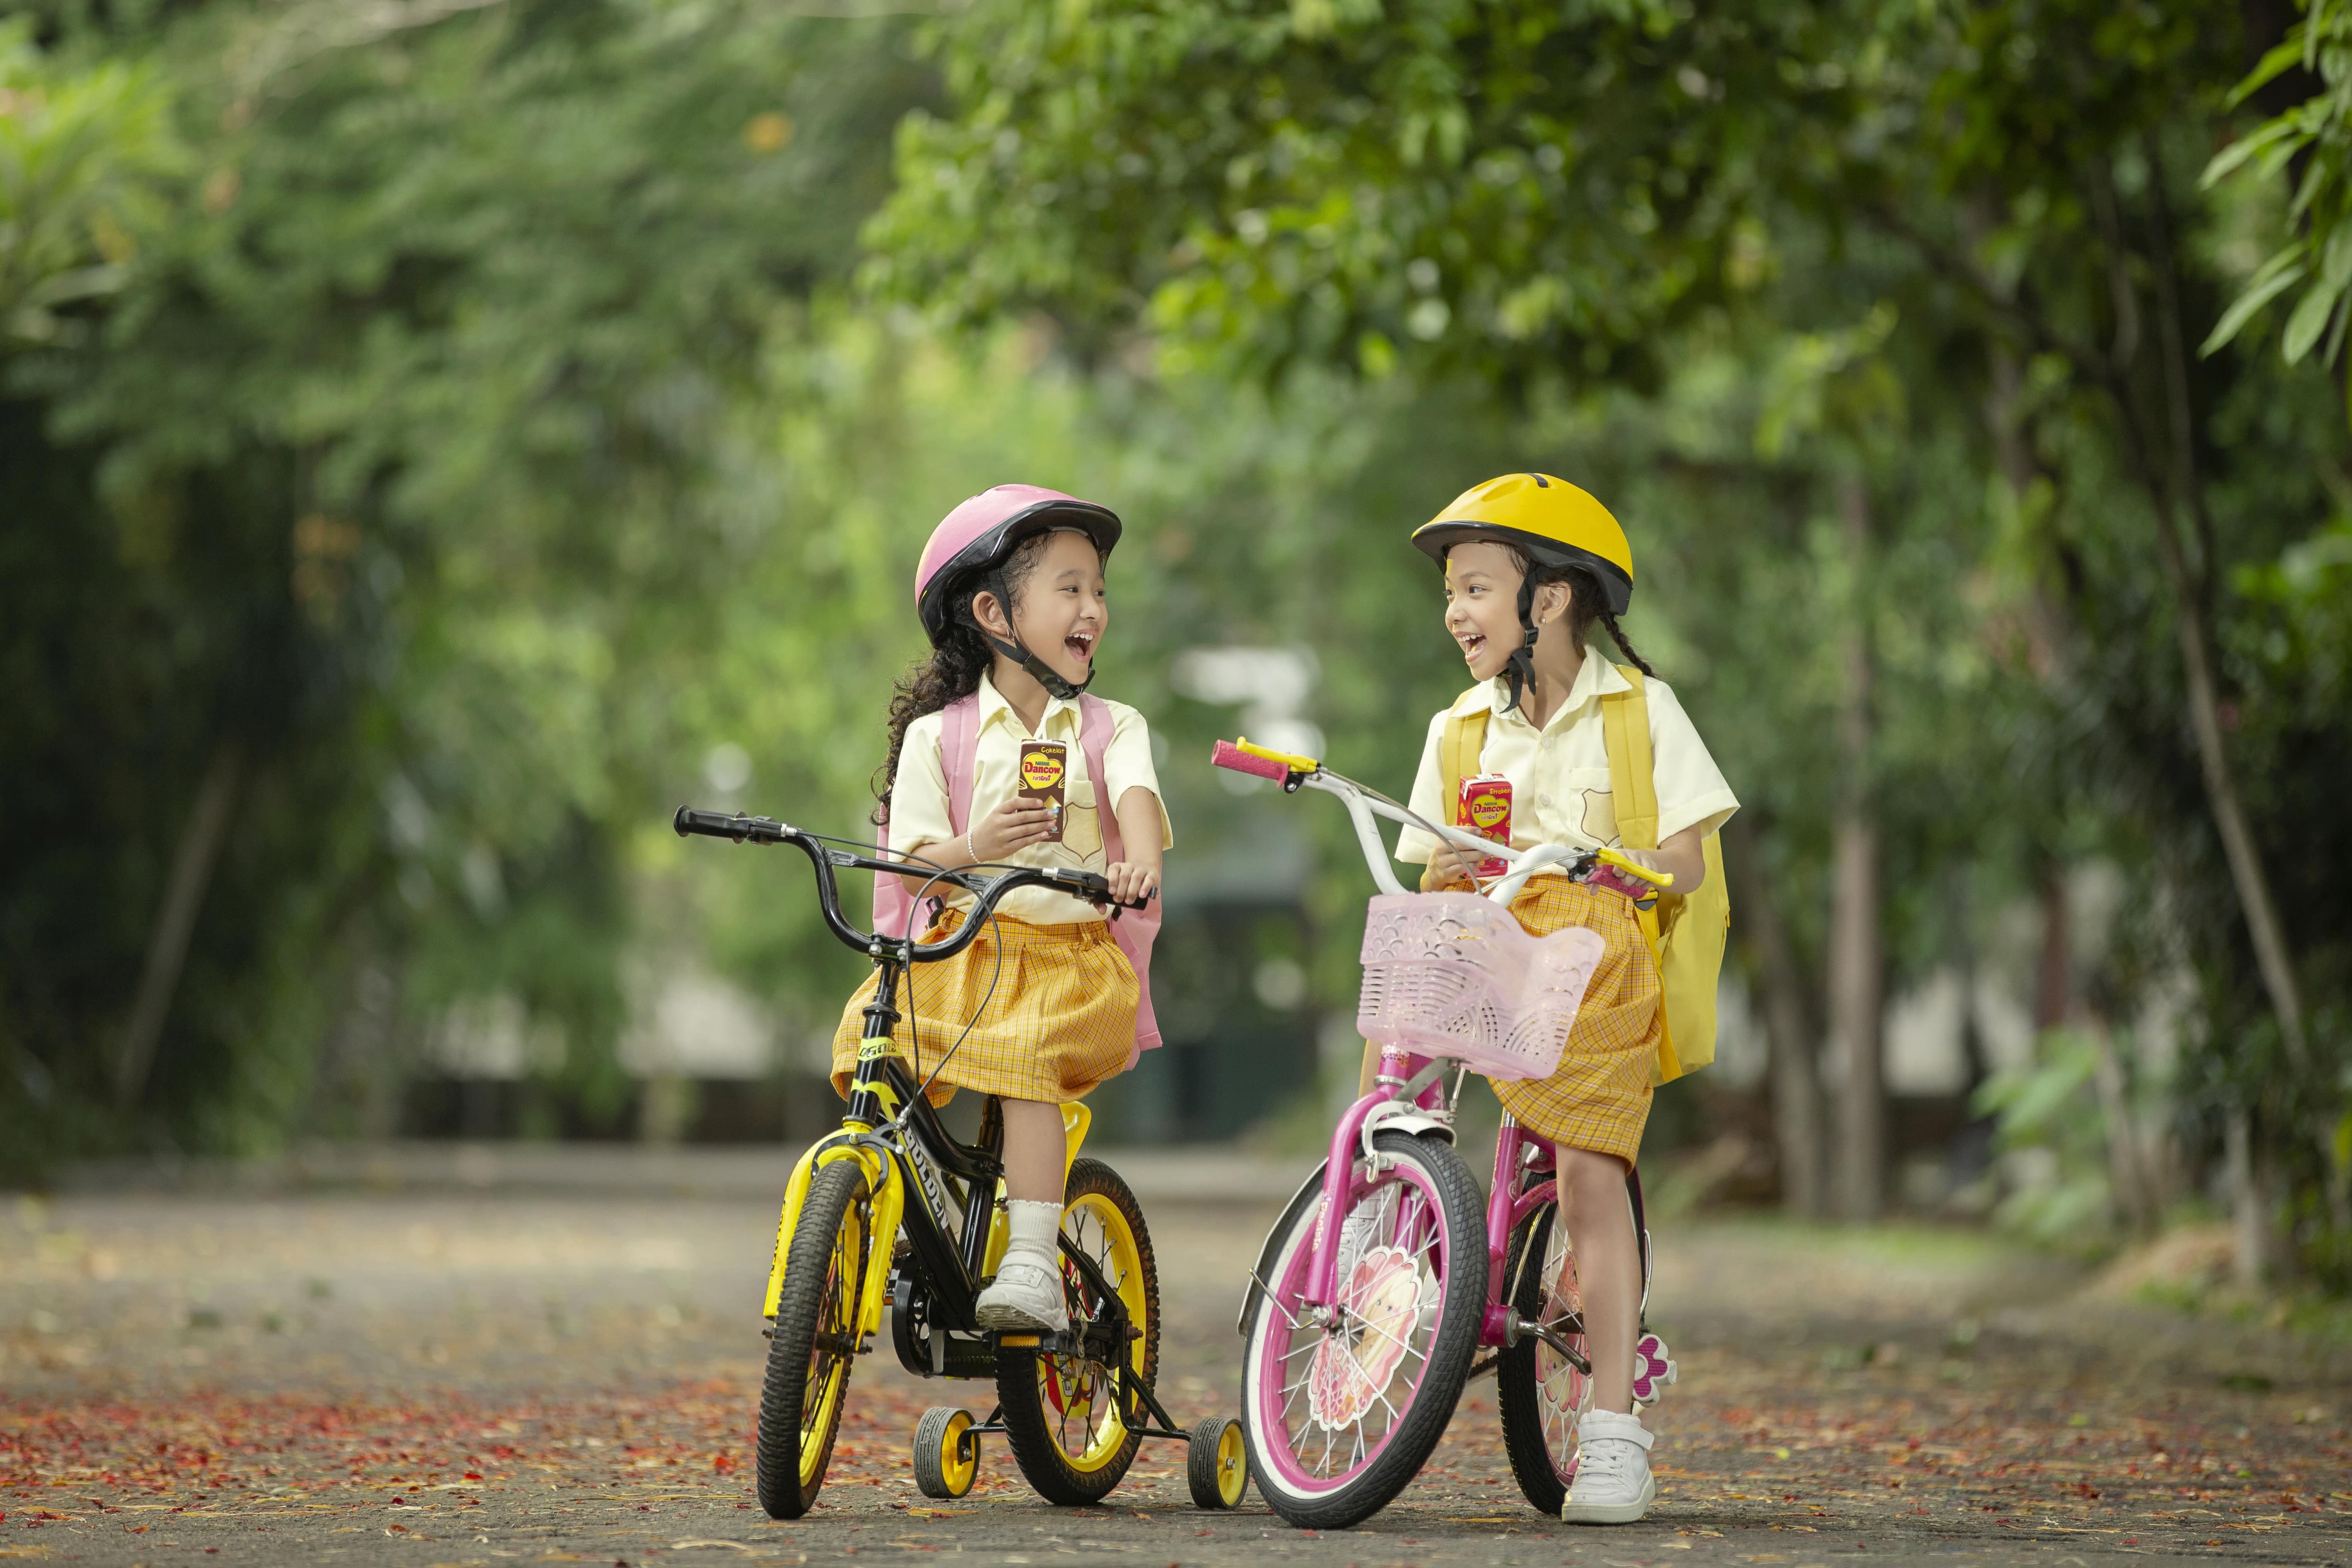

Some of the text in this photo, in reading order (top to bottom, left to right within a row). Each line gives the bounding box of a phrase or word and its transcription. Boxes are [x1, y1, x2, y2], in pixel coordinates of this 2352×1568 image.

[1025, 762, 1060, 774] Dancow
[1474, 804, 1507, 814] Dancow
[904, 1126, 949, 1230] GOLDEN
